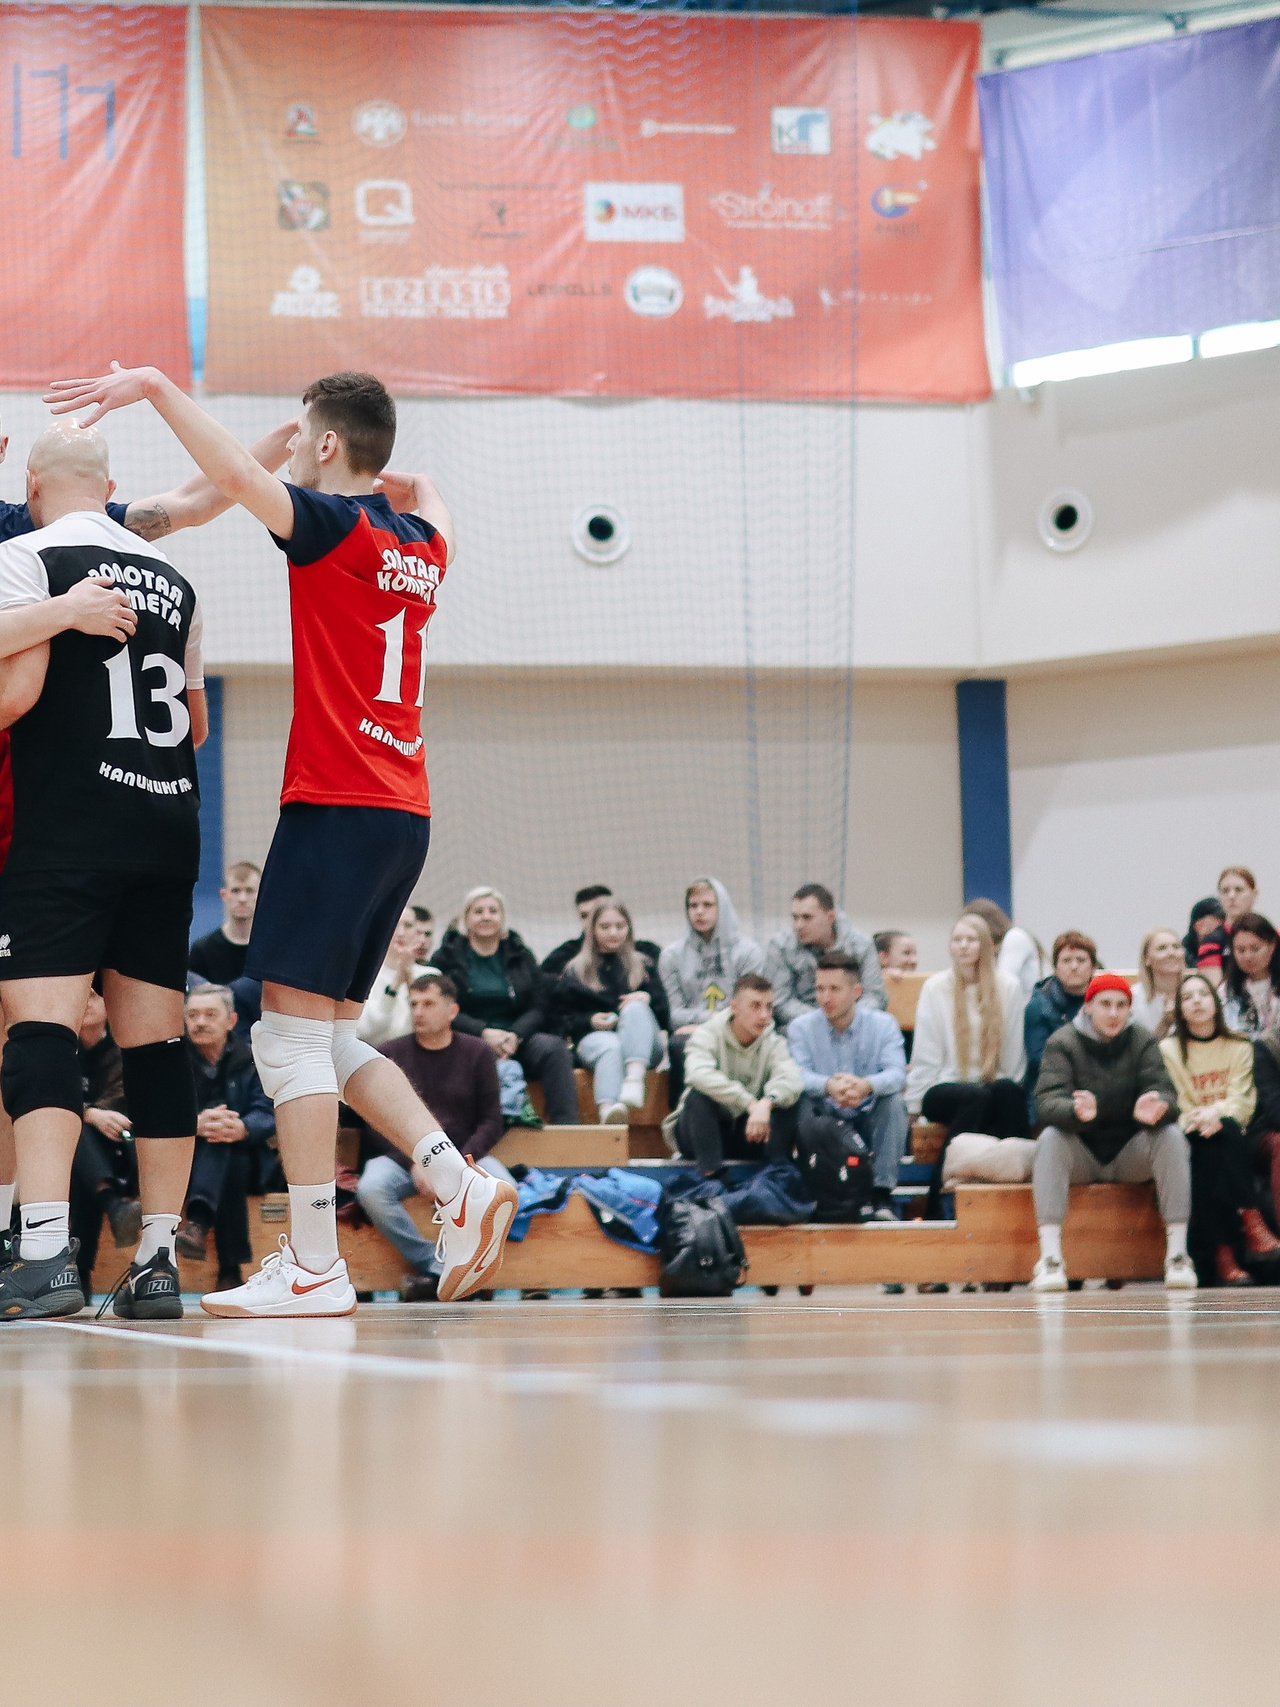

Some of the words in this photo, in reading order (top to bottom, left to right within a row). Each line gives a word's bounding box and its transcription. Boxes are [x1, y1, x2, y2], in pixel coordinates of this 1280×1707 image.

[112, 586, 183, 632] МЕТА
[101, 643, 192, 748] 13
[50, 1272, 78, 1289] MIZ
